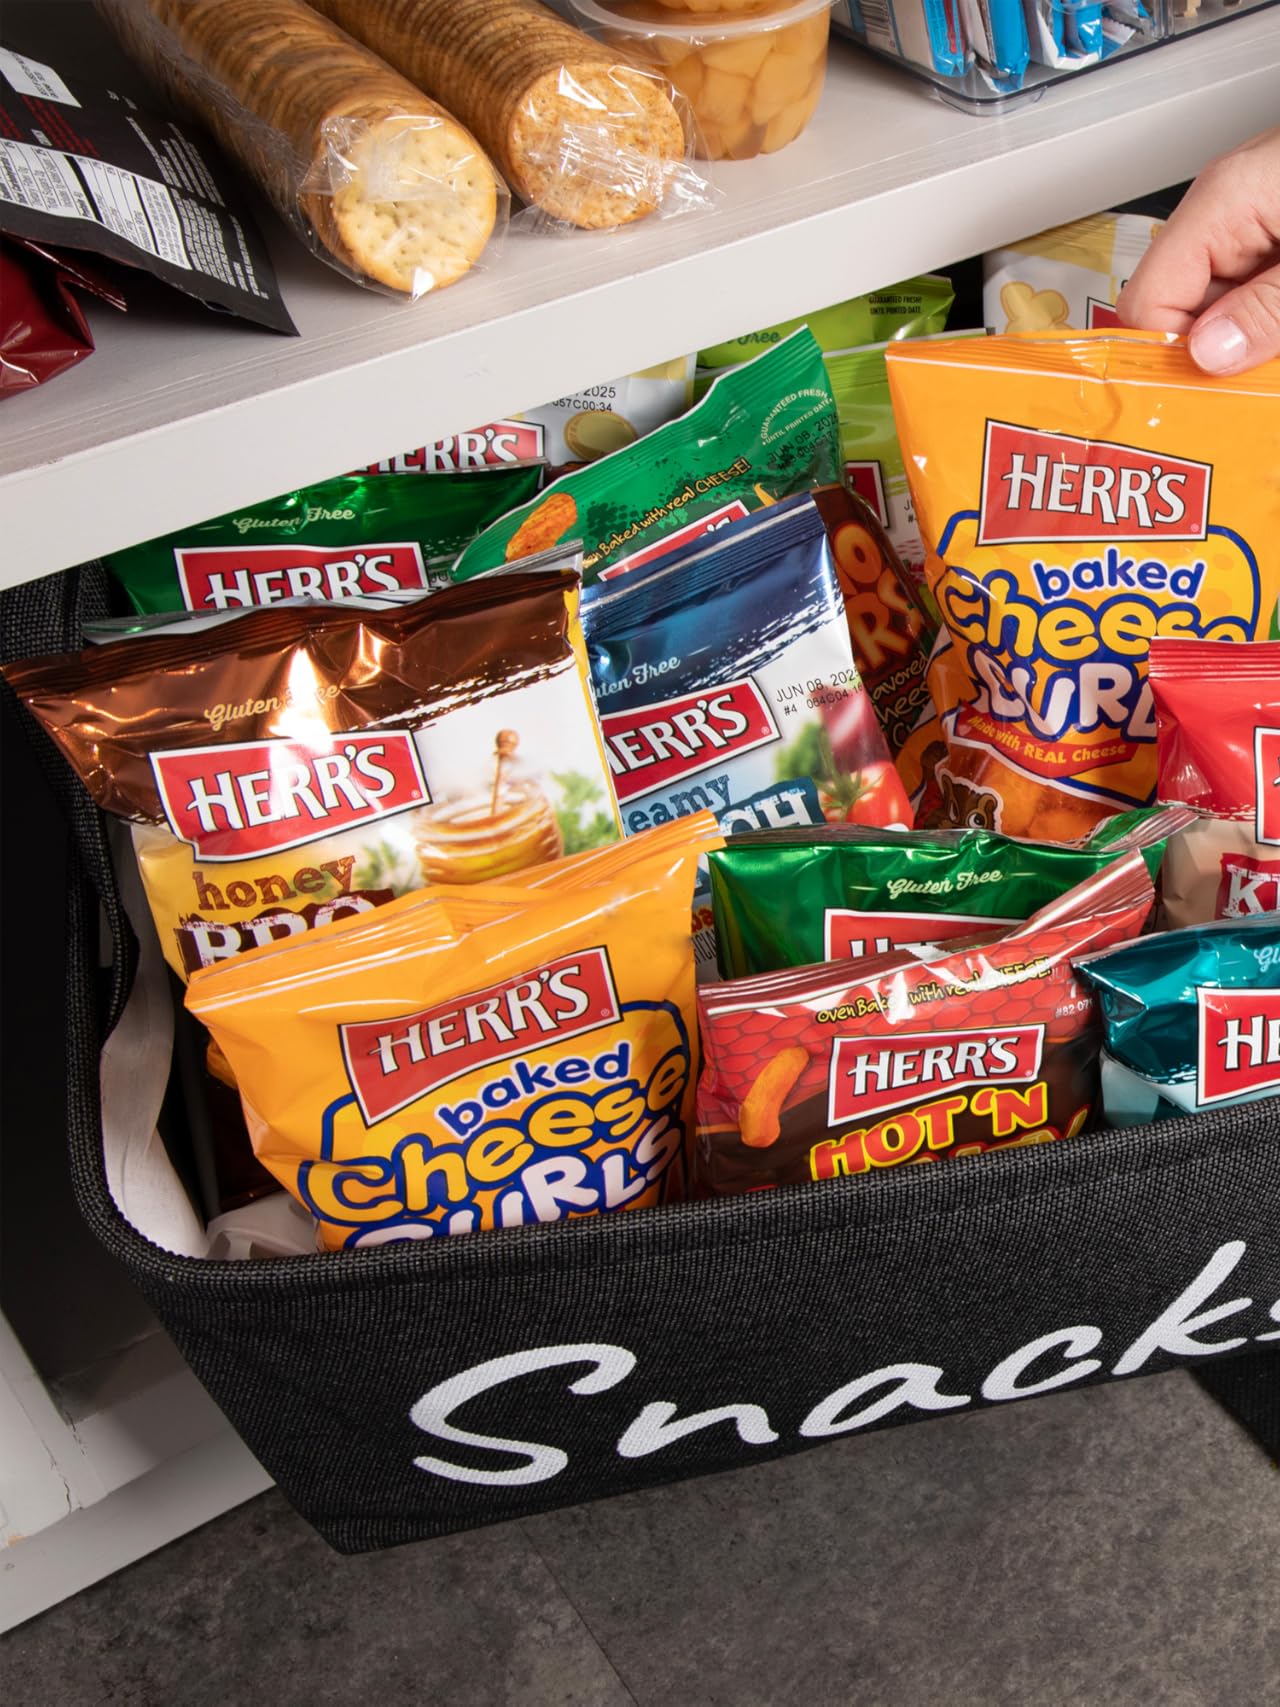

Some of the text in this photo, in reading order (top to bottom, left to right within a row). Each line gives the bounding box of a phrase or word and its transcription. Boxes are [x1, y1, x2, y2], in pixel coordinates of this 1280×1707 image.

[598, 522, 641, 556] Baked
[639, 504, 668, 529] with
[666, 485, 697, 511] real
[695, 456, 753, 494] CHEESE!
[1001, 453, 1188, 529] HERR'S
[232, 505, 357, 535] Gluten Free
[204, 553, 401, 609] HERR'S
[1032, 545, 1206, 601] baked
[632, 656, 681, 685] Free
[776, 684, 805, 703] JUN
[830, 669, 857, 687] 202
[969, 648, 1158, 739] CURL
[204, 696, 282, 732] Gluten
[784, 703, 798, 717] #4
[967, 714, 1128, 765] Made with REAL Cheese
[187, 744, 397, 835] HERR'S
[622, 774, 731, 834] eamy
[191, 854, 357, 911] honey
[886, 869, 1004, 900] Gluten Free
[367, 963, 590, 1077] HERR'S
[816, 1001, 855, 1024] Oven
[908, 981, 945, 1005] with
[436, 1039, 632, 1141] baked
[846, 1035, 1021, 1097] HERR'S
[809, 1094, 969, 1182] HOT
